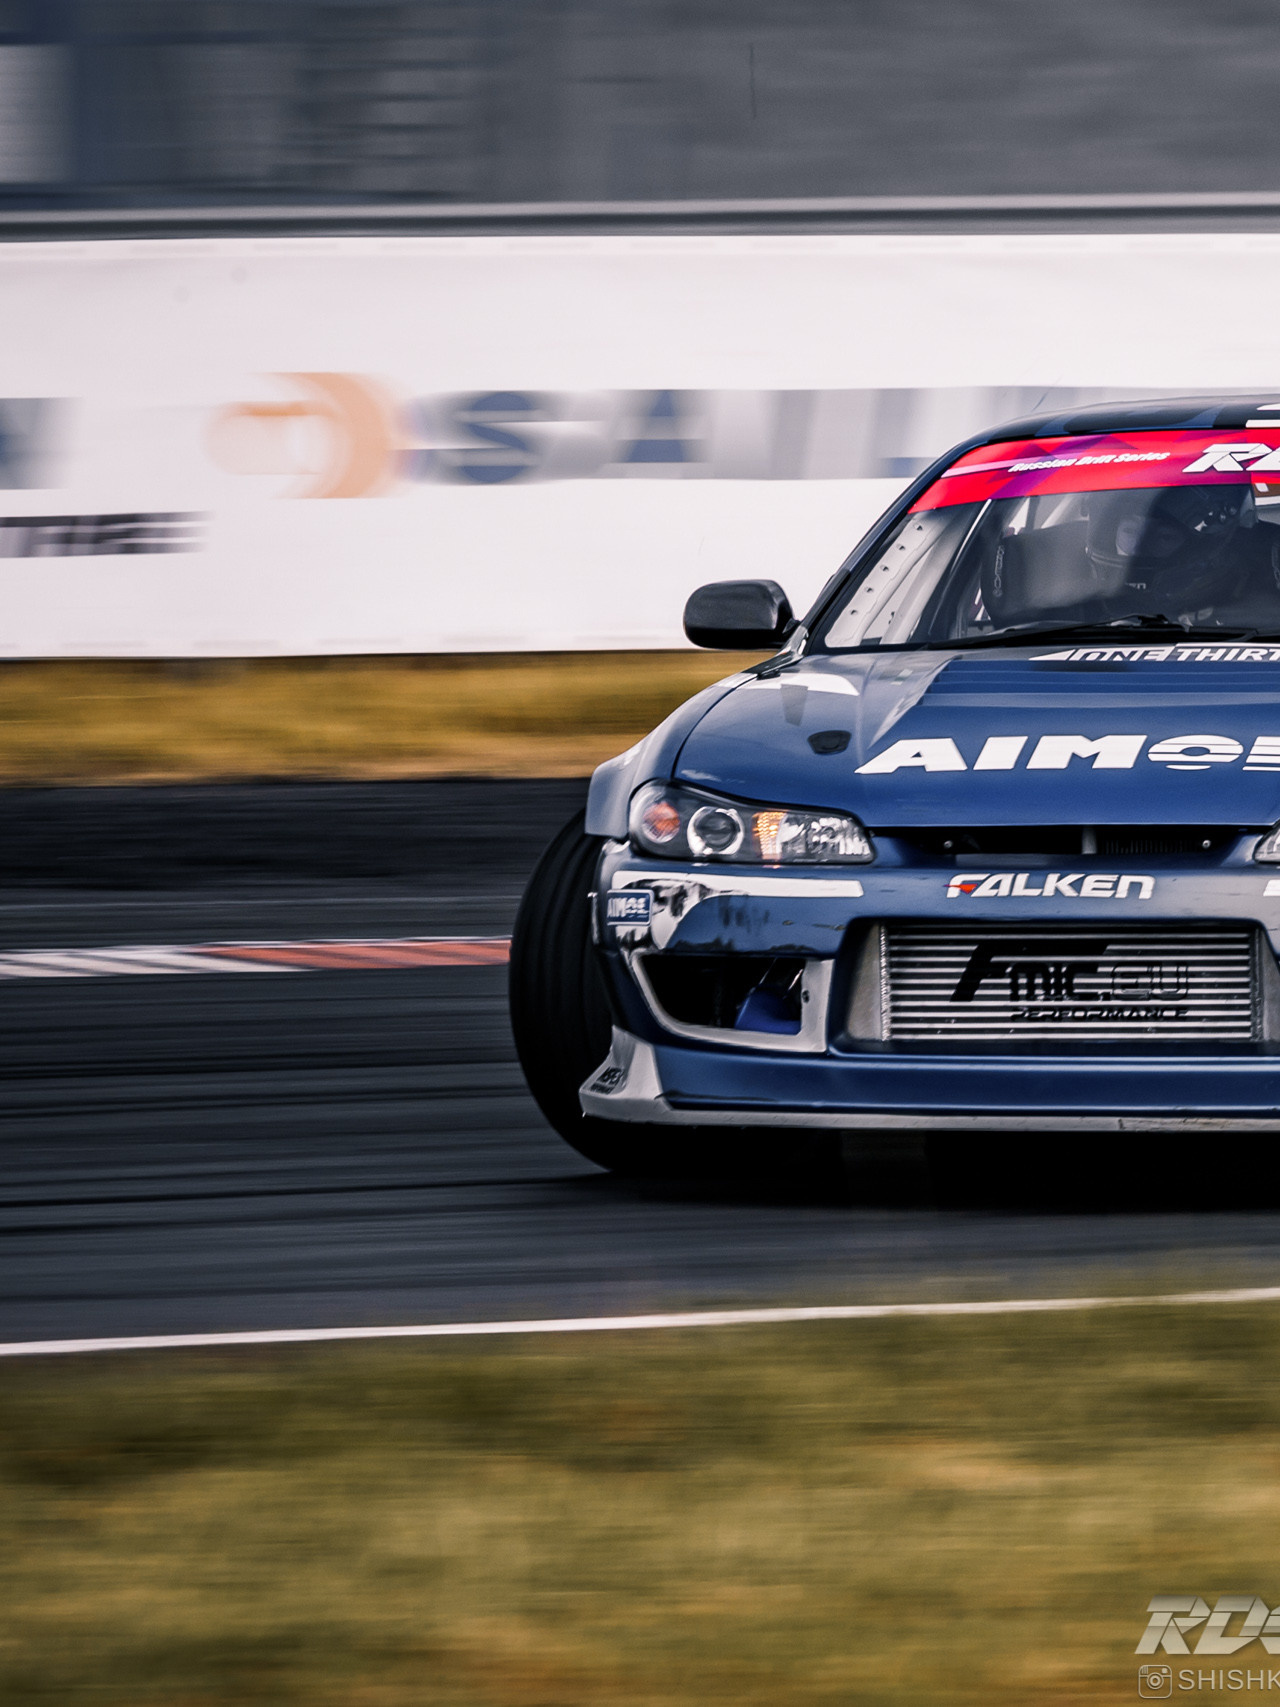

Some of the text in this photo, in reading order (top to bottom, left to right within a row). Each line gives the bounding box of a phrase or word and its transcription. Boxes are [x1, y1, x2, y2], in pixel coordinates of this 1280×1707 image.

[1008, 452, 1170, 472] Russian Drift Series
[945, 873, 1156, 899] FALKEN
[1010, 1006, 1190, 1021] PERFORMANCE
